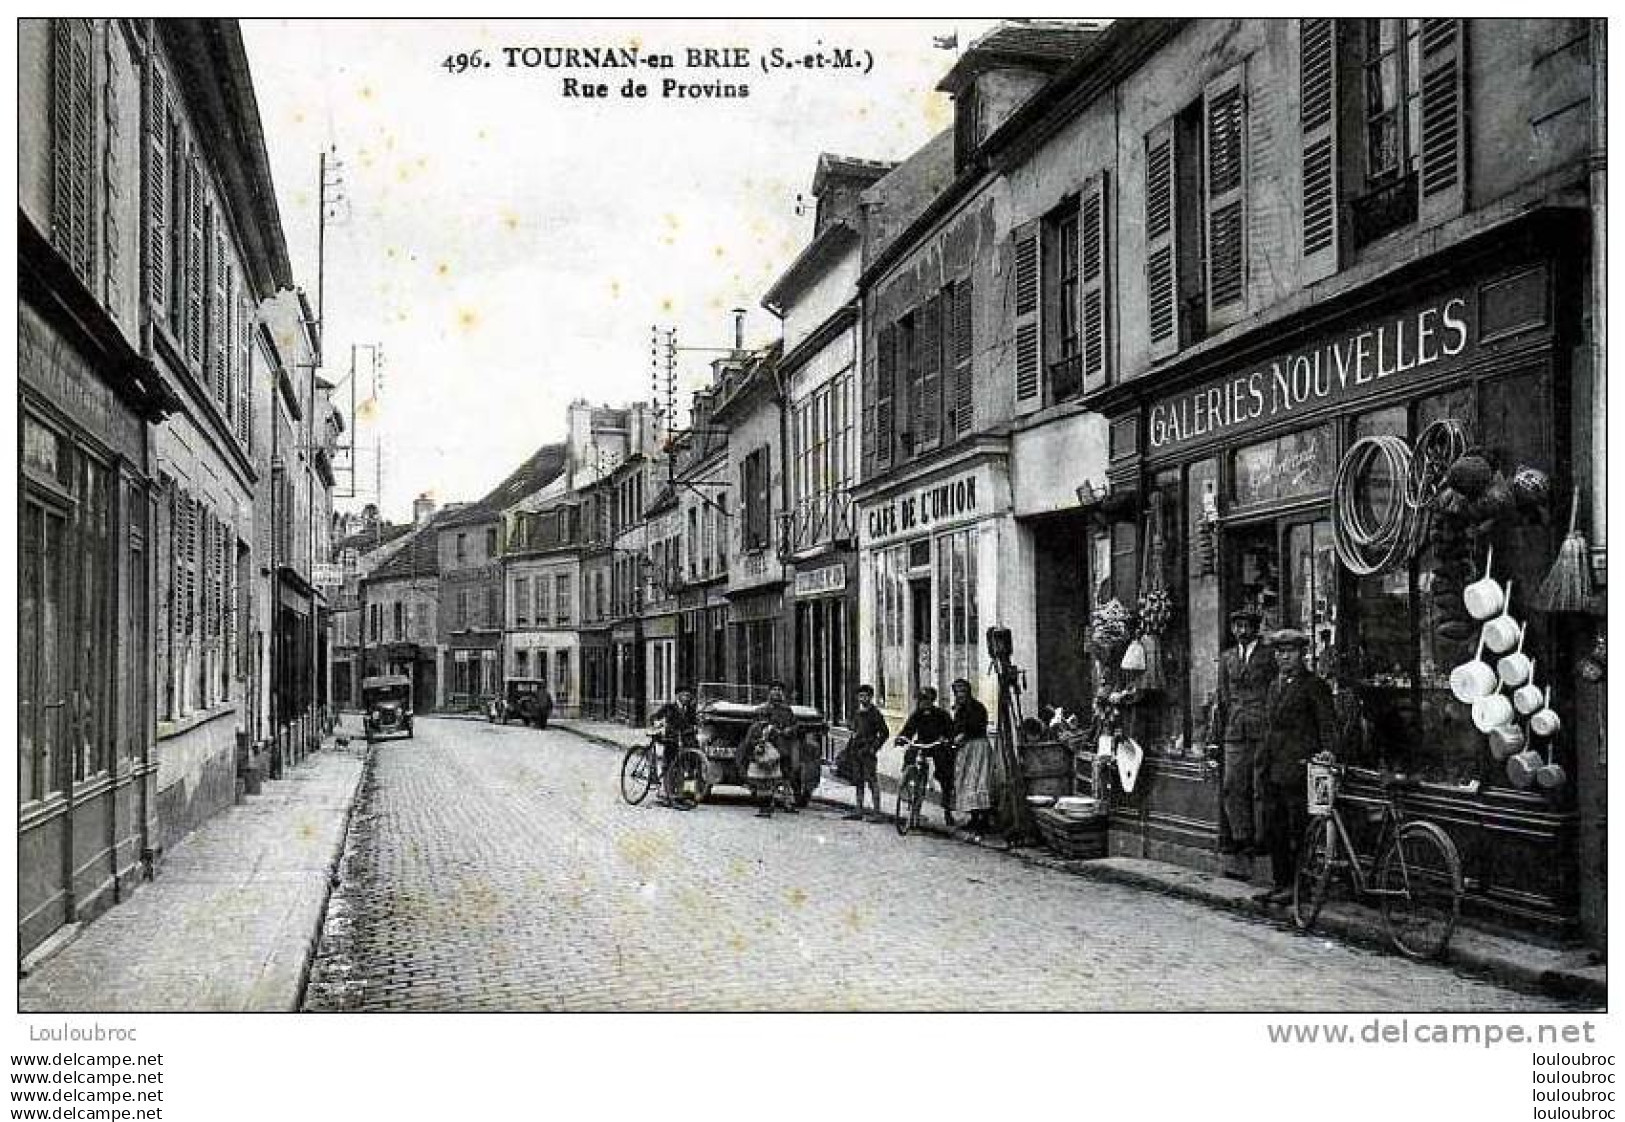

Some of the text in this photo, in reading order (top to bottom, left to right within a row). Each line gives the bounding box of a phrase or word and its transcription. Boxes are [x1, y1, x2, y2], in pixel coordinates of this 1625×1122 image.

[1150, 297, 1467, 446] GALERIES NOUVELLES
[901, 496, 916, 531] DE
